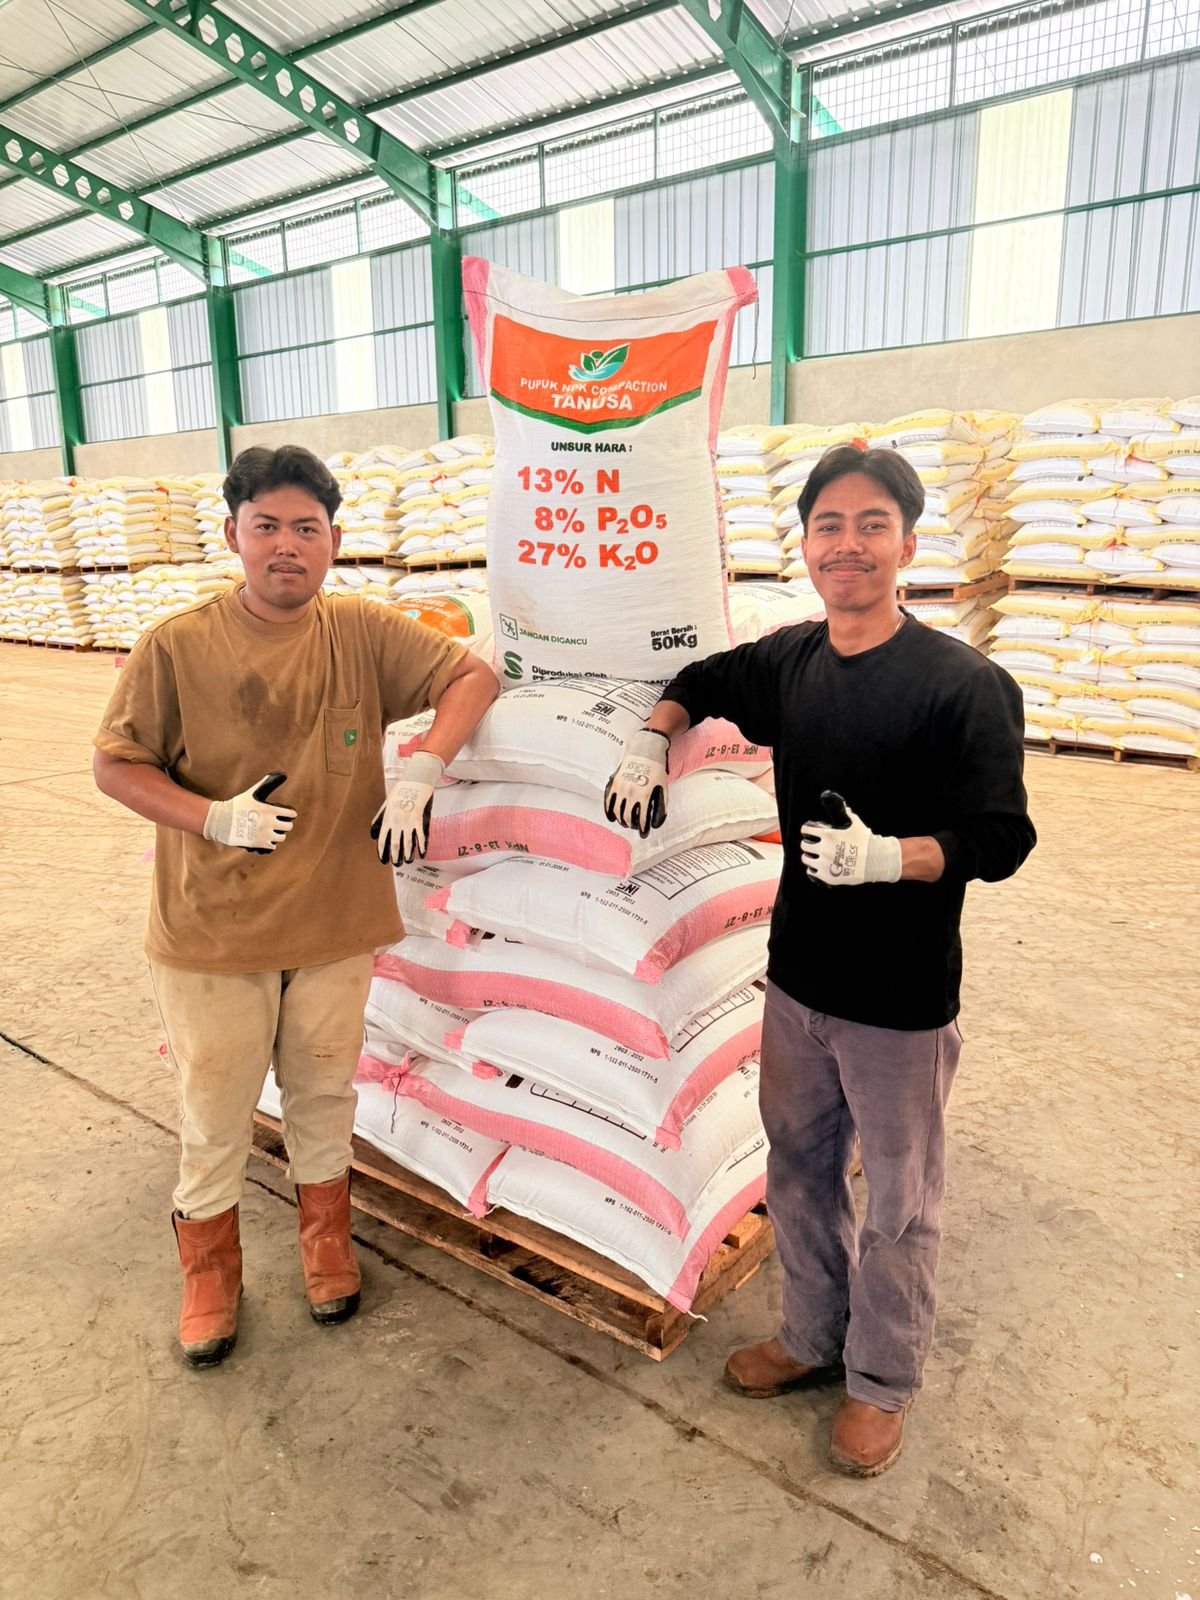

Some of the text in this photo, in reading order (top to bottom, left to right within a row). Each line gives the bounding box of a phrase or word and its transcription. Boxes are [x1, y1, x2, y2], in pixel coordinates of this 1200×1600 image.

[520, 377, 558, 391] PUPUK
[592, 380, 667, 394] COMPACTION
[552, 394, 633, 410] TANUSA
[551, 442, 592, 452] UNSUR
[594, 443, 627, 453] HARA
[517, 466, 620, 494] 13% N
[534, 506, 585, 534] 8%
[518, 540, 658, 571] 27% K2O
[520, 629, 588, 646] JANGAN DIGANCU
[650, 628, 670, 638] Berat
[671, 626, 694, 634] Bersih
[652, 633, 698, 651] 50Kg
[532, 666, 582, 678] Diproduksi
[591, 702, 618, 718] SNI
[458, 840, 501, 856] 13-8-27
